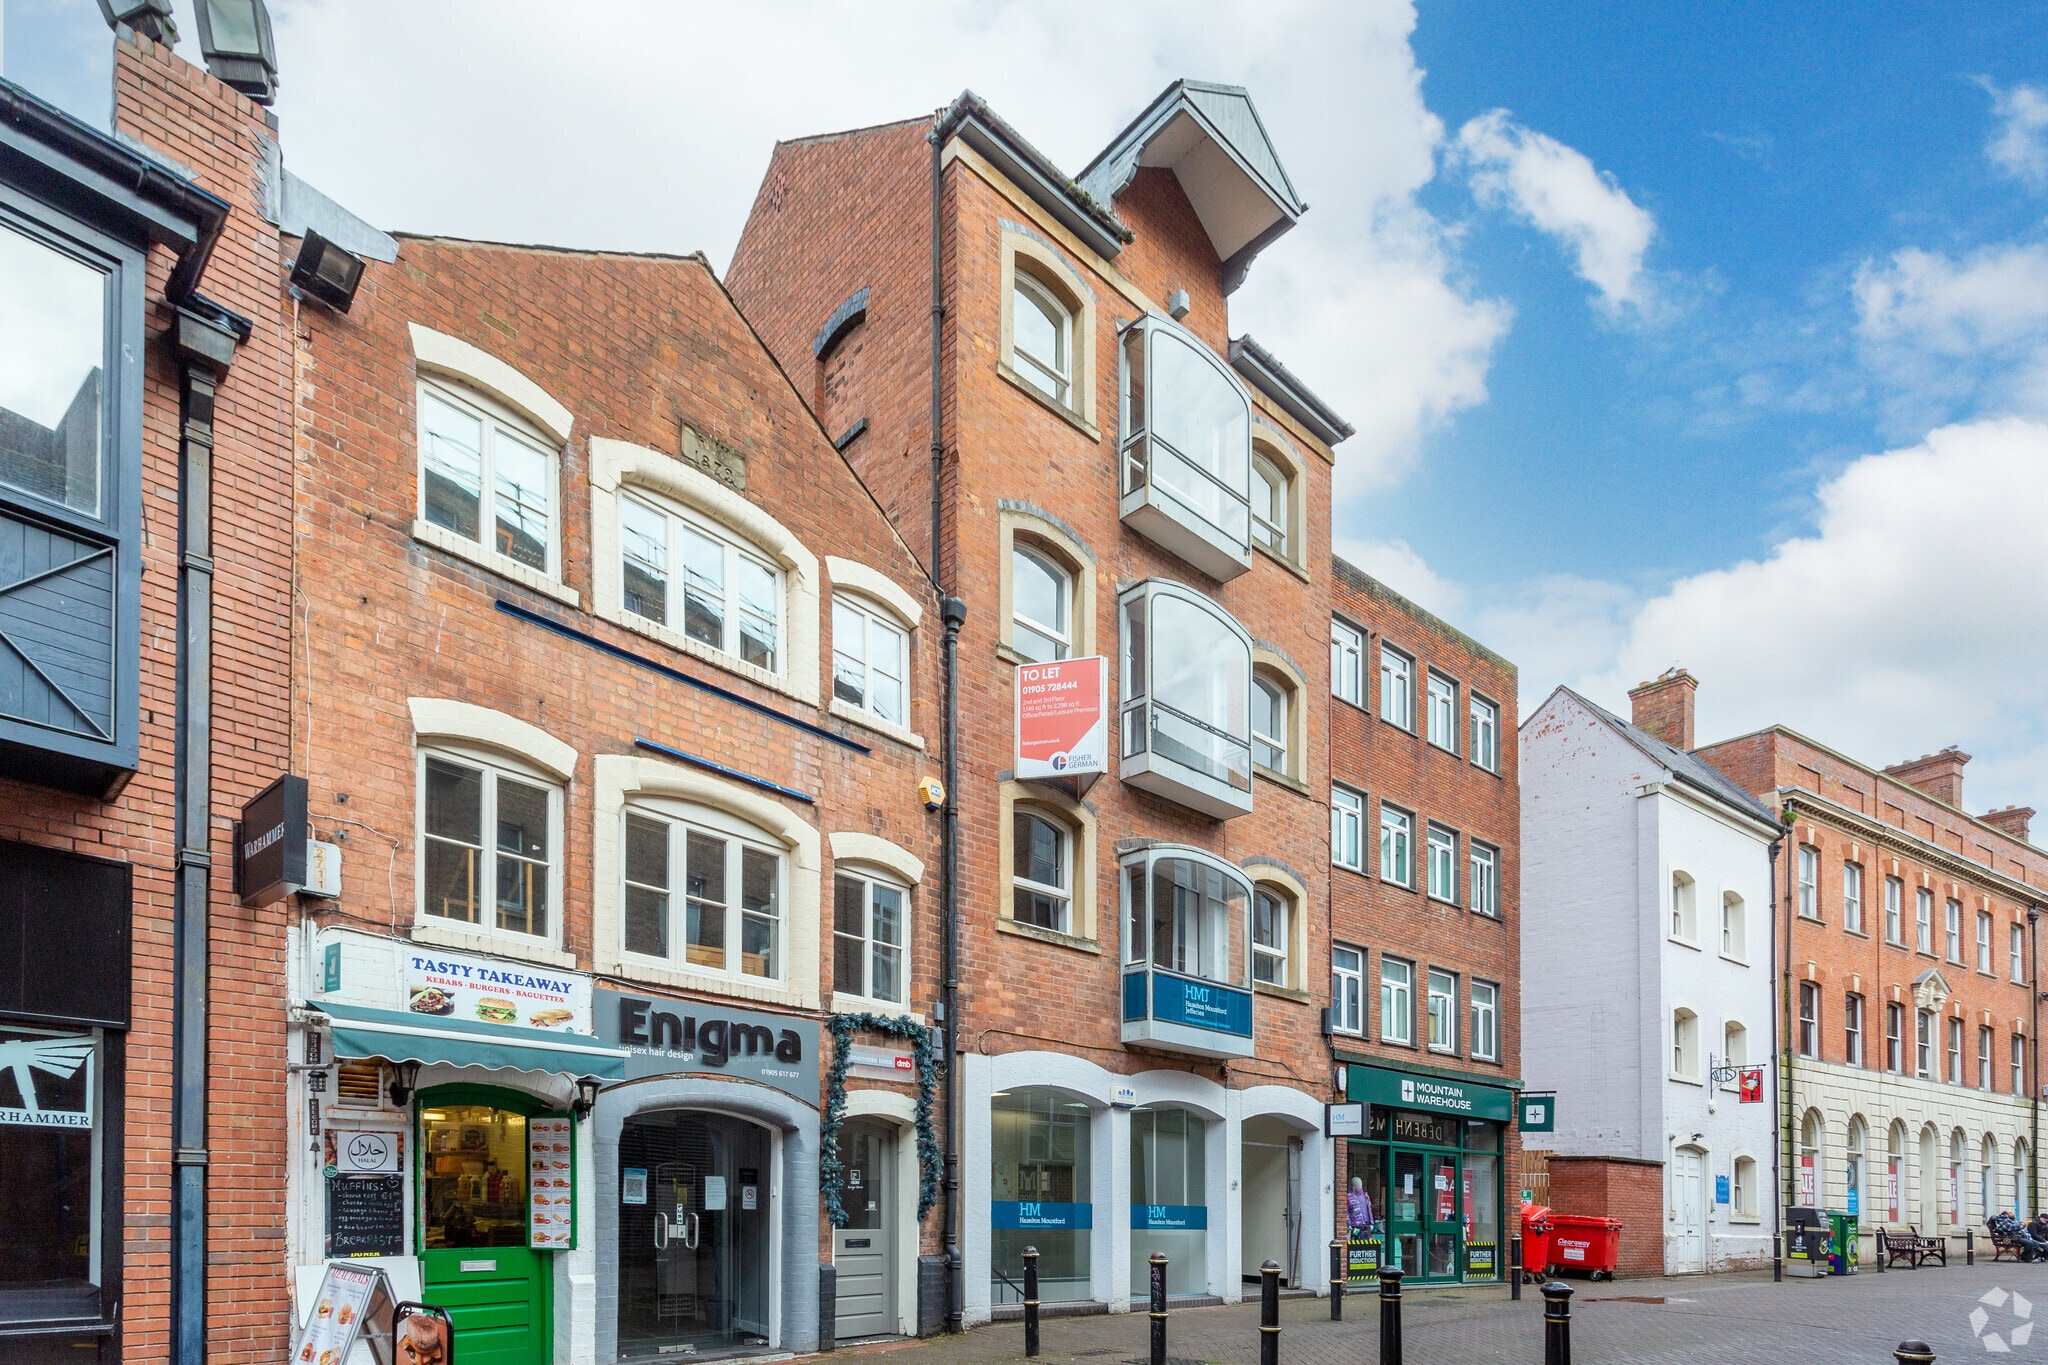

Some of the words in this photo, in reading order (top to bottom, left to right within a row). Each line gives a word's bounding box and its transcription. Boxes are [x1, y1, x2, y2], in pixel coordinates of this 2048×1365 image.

[1022, 669, 1039, 682] TO
[1042, 667, 1060, 680] LET
[1022, 684, 1046, 695] 01905
[1047, 681, 1077, 692] 728444
[1068, 754, 1092, 762] FISHER
[1068, 760, 1098, 769] GERMAN
[411, 957, 473, 978] TASTY
[477, 968, 572, 994] TAKEAWAY
[426, 975, 463, 988] KEBABS
[469, 983, 511, 995] BURGERS
[516, 989, 565, 1003] BAGUETTES
[619, 997, 802, 1067] Enigma
[619, 1045, 648, 1057] nisex
[648, 1046, 665, 1058] hair
[667, 1048, 694, 1062] design
[896, 1059, 911, 1068] dmb
[761, 1068, 778, 1078] 01905
[779, 1069, 790, 1078] 617
[789, 1070, 800, 1079] 677
[1416, 1082, 1463, 1098] MOUNTAIN
[1416, 1094, 1472, 1110] WAREHOUSE
[350, 1140, 385, 1156] حلال
[1019, 1202, 1042, 1217] HM
[1148, 1206, 1167, 1219] HM
[1041, 1217, 1066, 1226] Mountford
[1349, 1249, 1377, 1258] FURTHER
[1469, 1250, 1492, 1258] FURTHER
[331, 1269, 349, 1282] MEAL
[347, 1272, 369, 1285] DEALS
